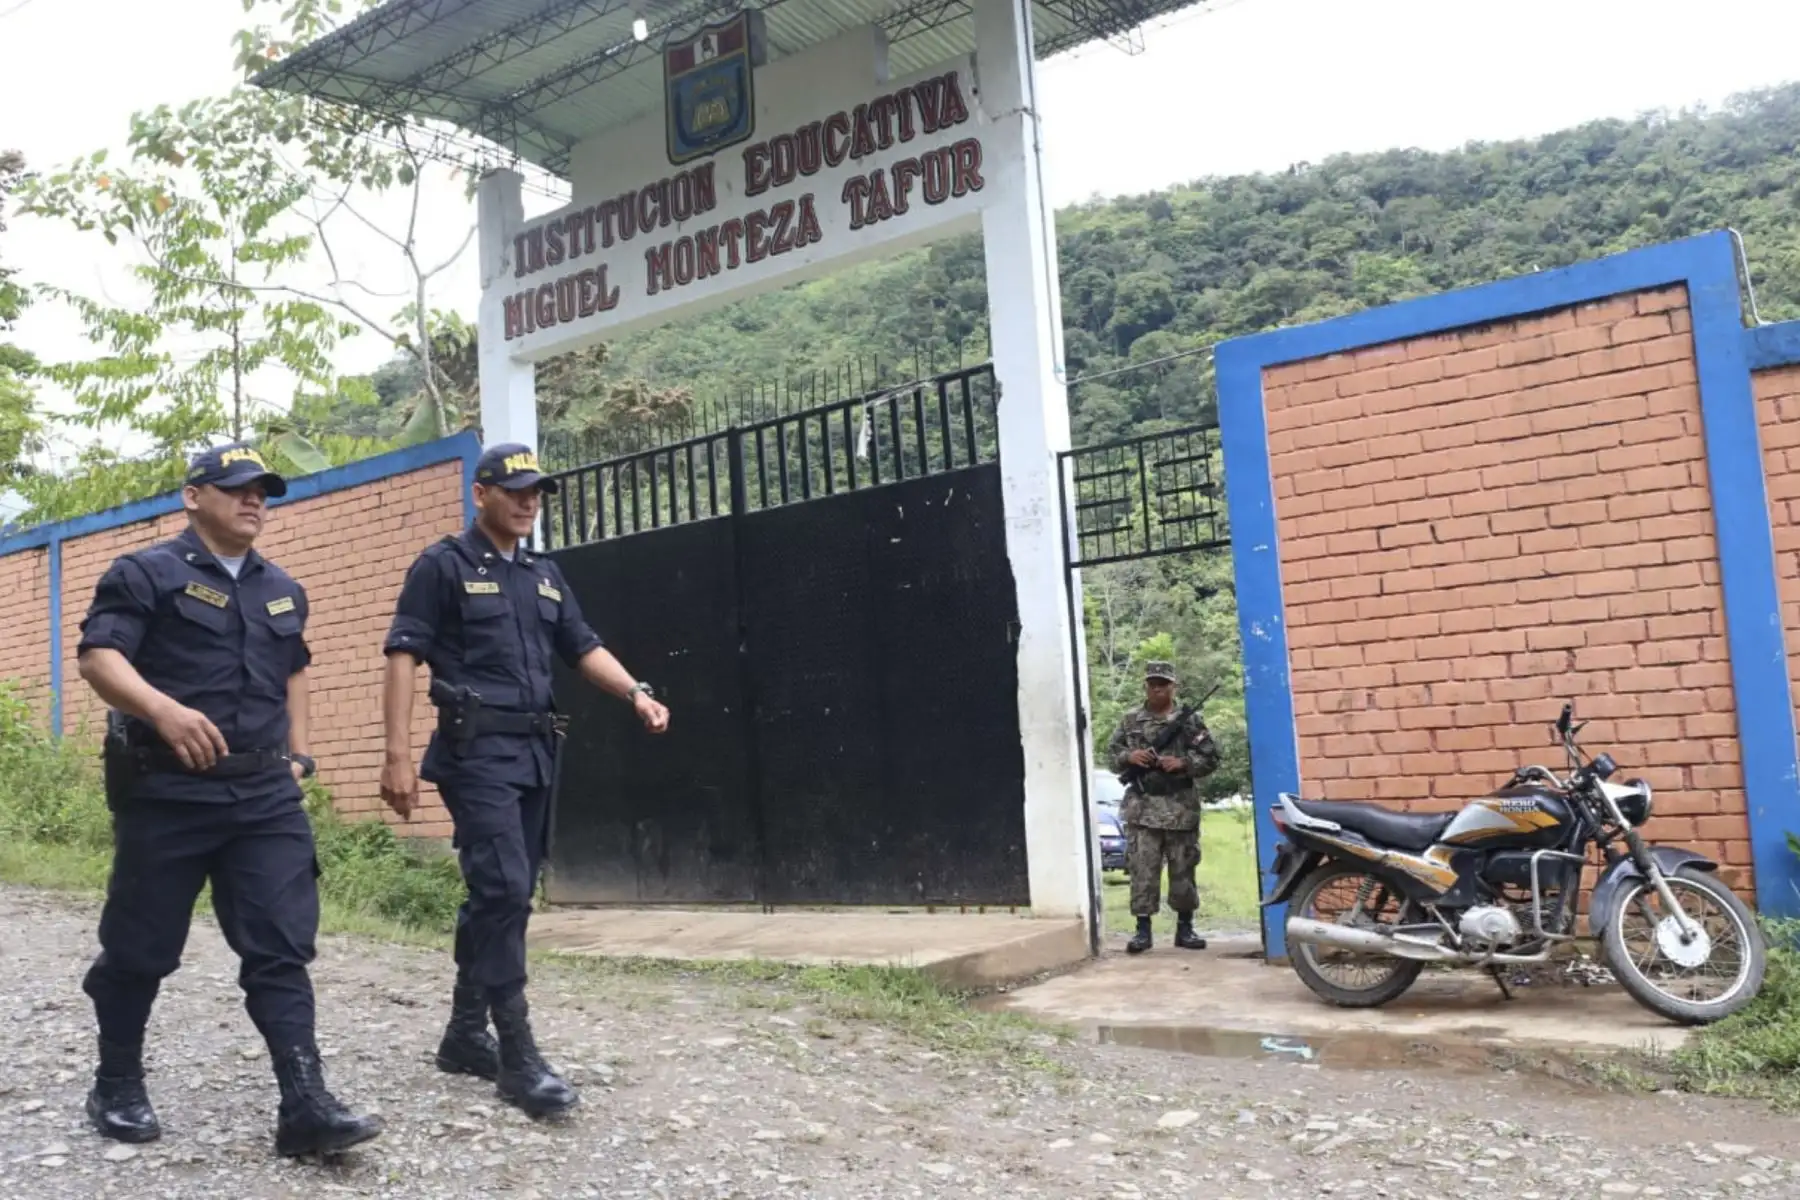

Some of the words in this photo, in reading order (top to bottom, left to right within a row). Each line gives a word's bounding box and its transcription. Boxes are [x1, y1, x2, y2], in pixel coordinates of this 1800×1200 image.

[503, 263, 620, 341] MIGUEL
[644, 193, 823, 295] MONTEZA
[841, 138, 984, 230] TAFUR
[514, 160, 717, 278] INSTITUCION
[743, 71, 969, 197] EDUCATIVA
